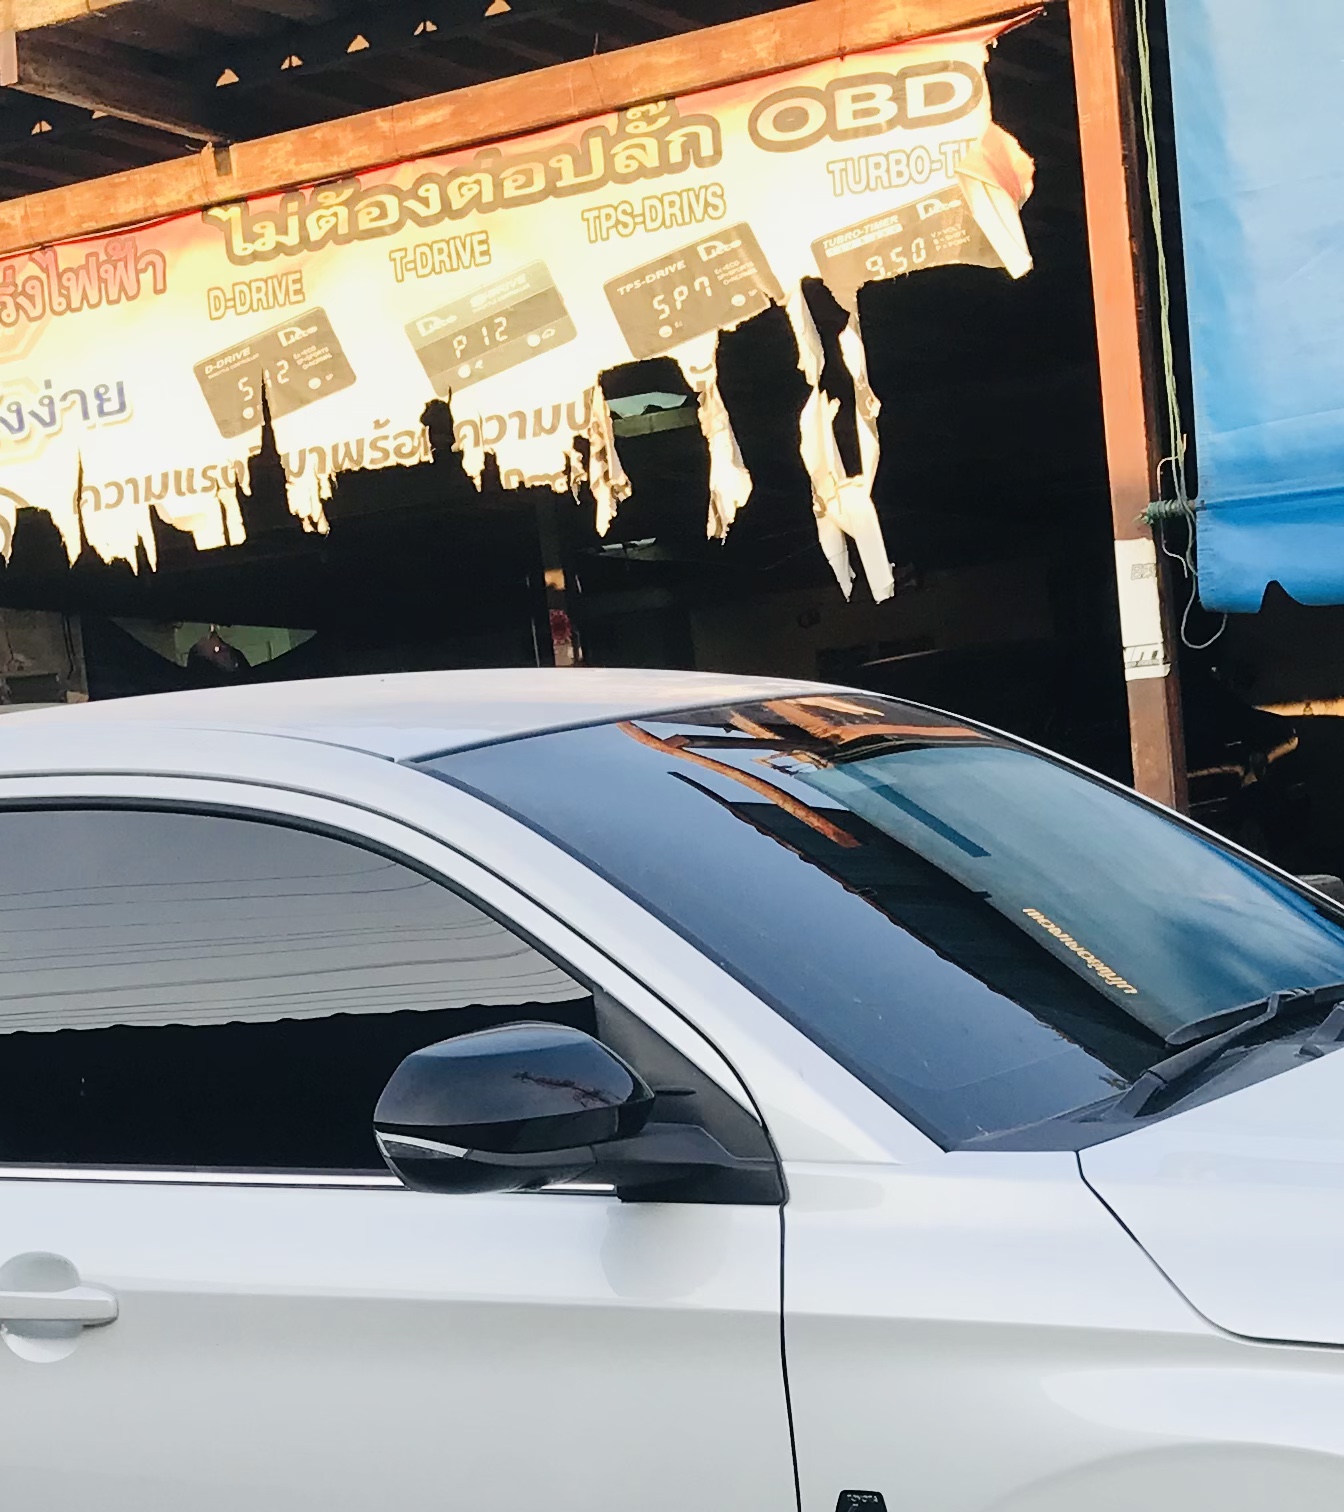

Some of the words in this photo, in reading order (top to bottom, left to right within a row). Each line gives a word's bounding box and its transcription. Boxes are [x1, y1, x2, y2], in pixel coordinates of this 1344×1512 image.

[751, 63, 980, 150] OBD
[827, 137, 977, 198] TURBO-TI
[581, 182, 727, 244] TPS-DRIVS
[389, 230, 492, 283] T-DRIVE
[617, 260, 687, 295] TPS-DRIVE
[207, 270, 306, 321] D-DRIVE
